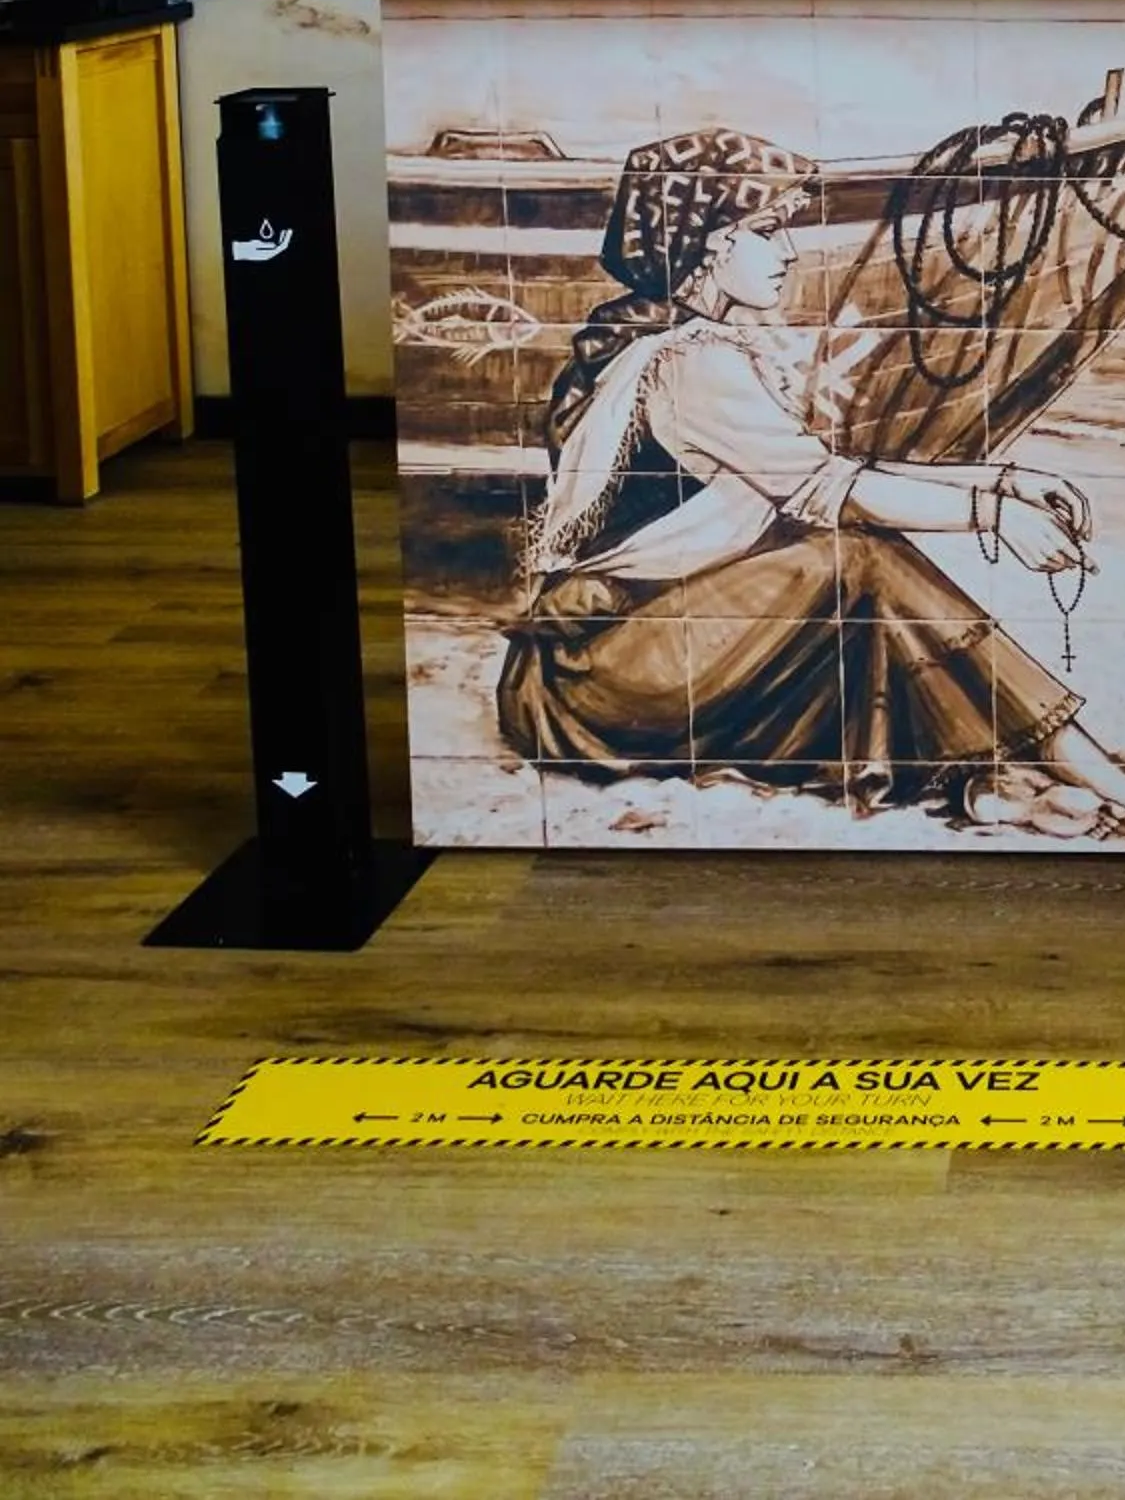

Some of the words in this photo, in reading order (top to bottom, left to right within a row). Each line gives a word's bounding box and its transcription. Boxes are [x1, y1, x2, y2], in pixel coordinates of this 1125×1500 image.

[467, 1069, 683, 1089] AGUARDE
[691, 1071, 799, 1094] AQUI
[809, 1071, 839, 1090] A
[855, 1071, 940, 1090] SUA
[956, 1071, 1040, 1090] VEZ
[567, 1093, 627, 1105] WAIT
[634, 1093, 708, 1106] HERE
[779, 1093, 850, 1106] YOUR
[862, 1093, 931, 1106] TURN
[411, 1112, 423, 1122] 2
[427, 1113, 446, 1122] M
[521, 1113, 620, 1124] CUMPRA
[628, 1114, 642, 1124] A
[651, 1111, 770, 1125] DISTÂNCIA
[779, 1114, 808, 1125] DE
[816, 1114, 960, 1127] SEGURANÇA
[1040, 1115, 1051, 1125] 2
[1057, 1116, 1075, 1125] M
